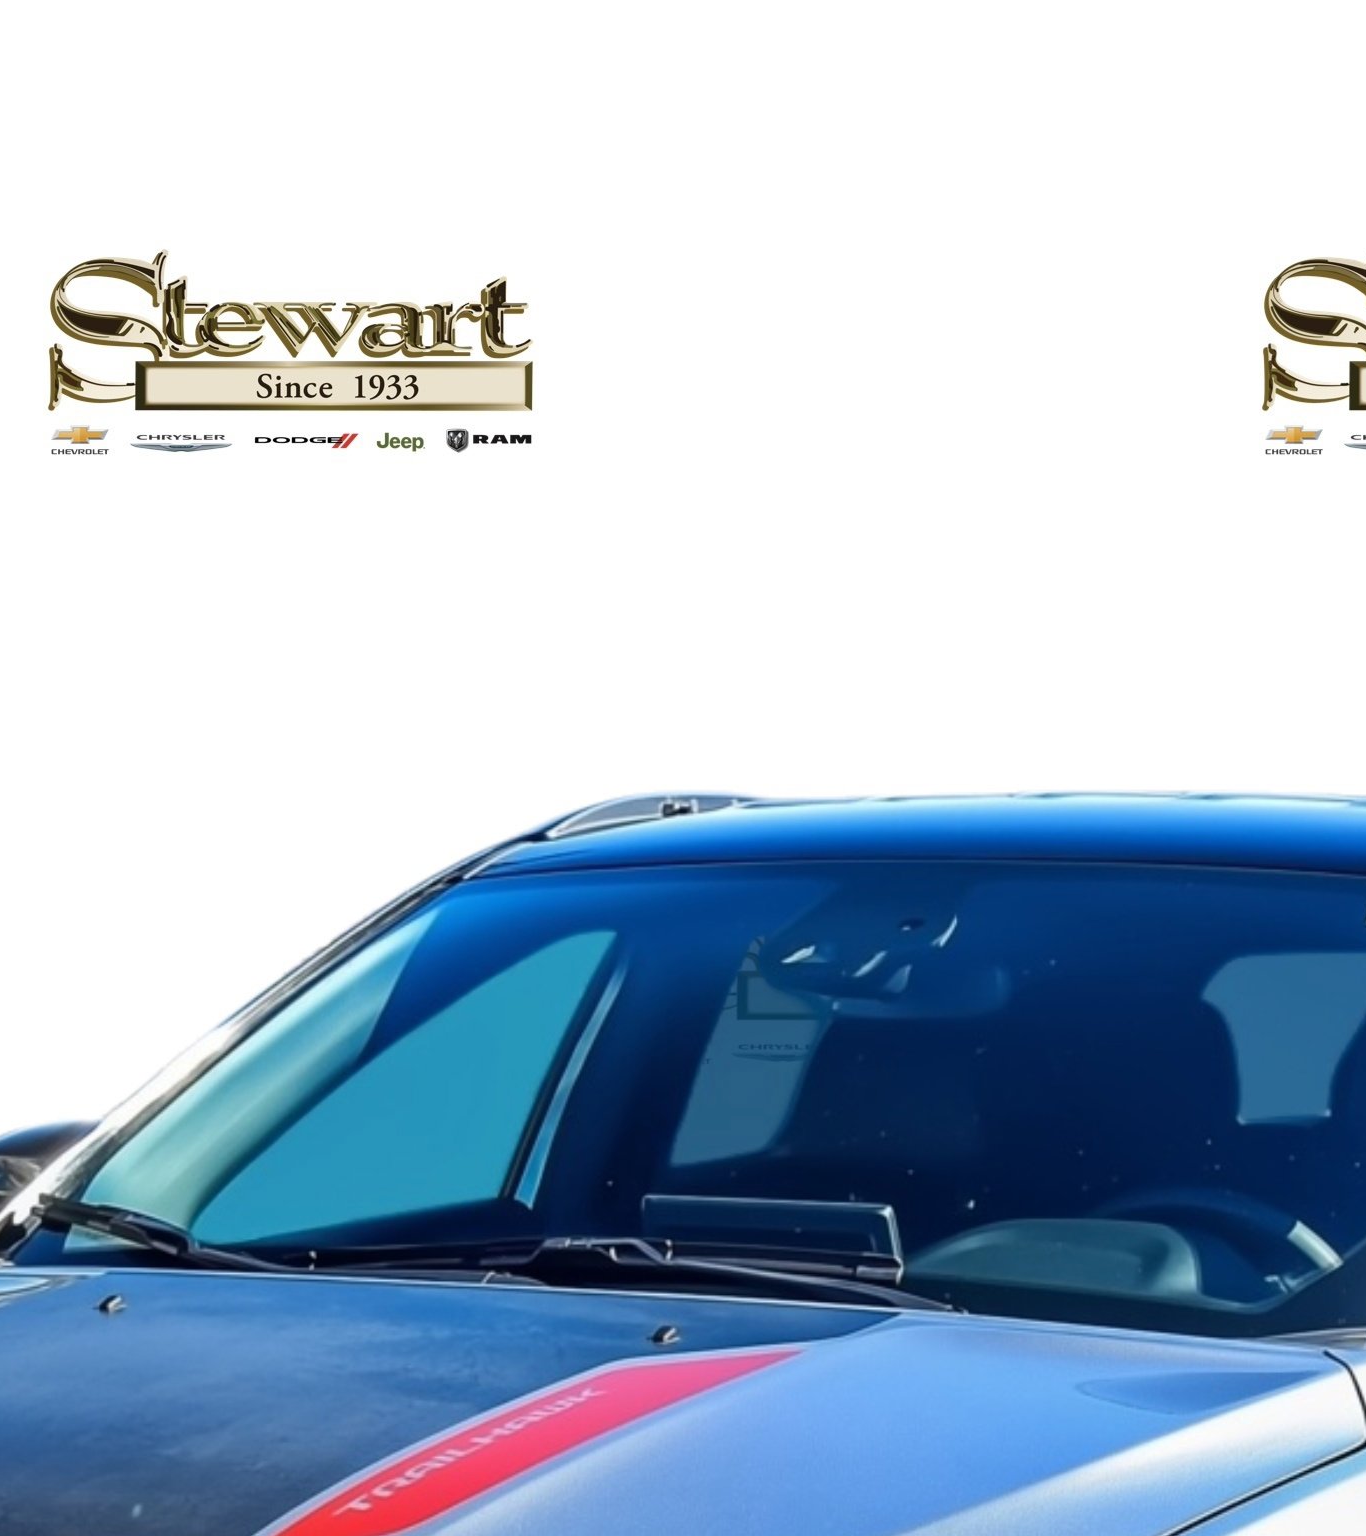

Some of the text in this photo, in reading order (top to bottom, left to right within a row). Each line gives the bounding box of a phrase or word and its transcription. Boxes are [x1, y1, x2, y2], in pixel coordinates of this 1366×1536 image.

[48, 249, 532, 410] Stewart
[256, 373, 420, 401] Since 1933
[254, 436, 343, 444] DODGE
[376, 432, 426, 452] Jeep
[472, 434, 533, 444] RAM
[331, 1387, 609, 1516] TRAILHAWK
